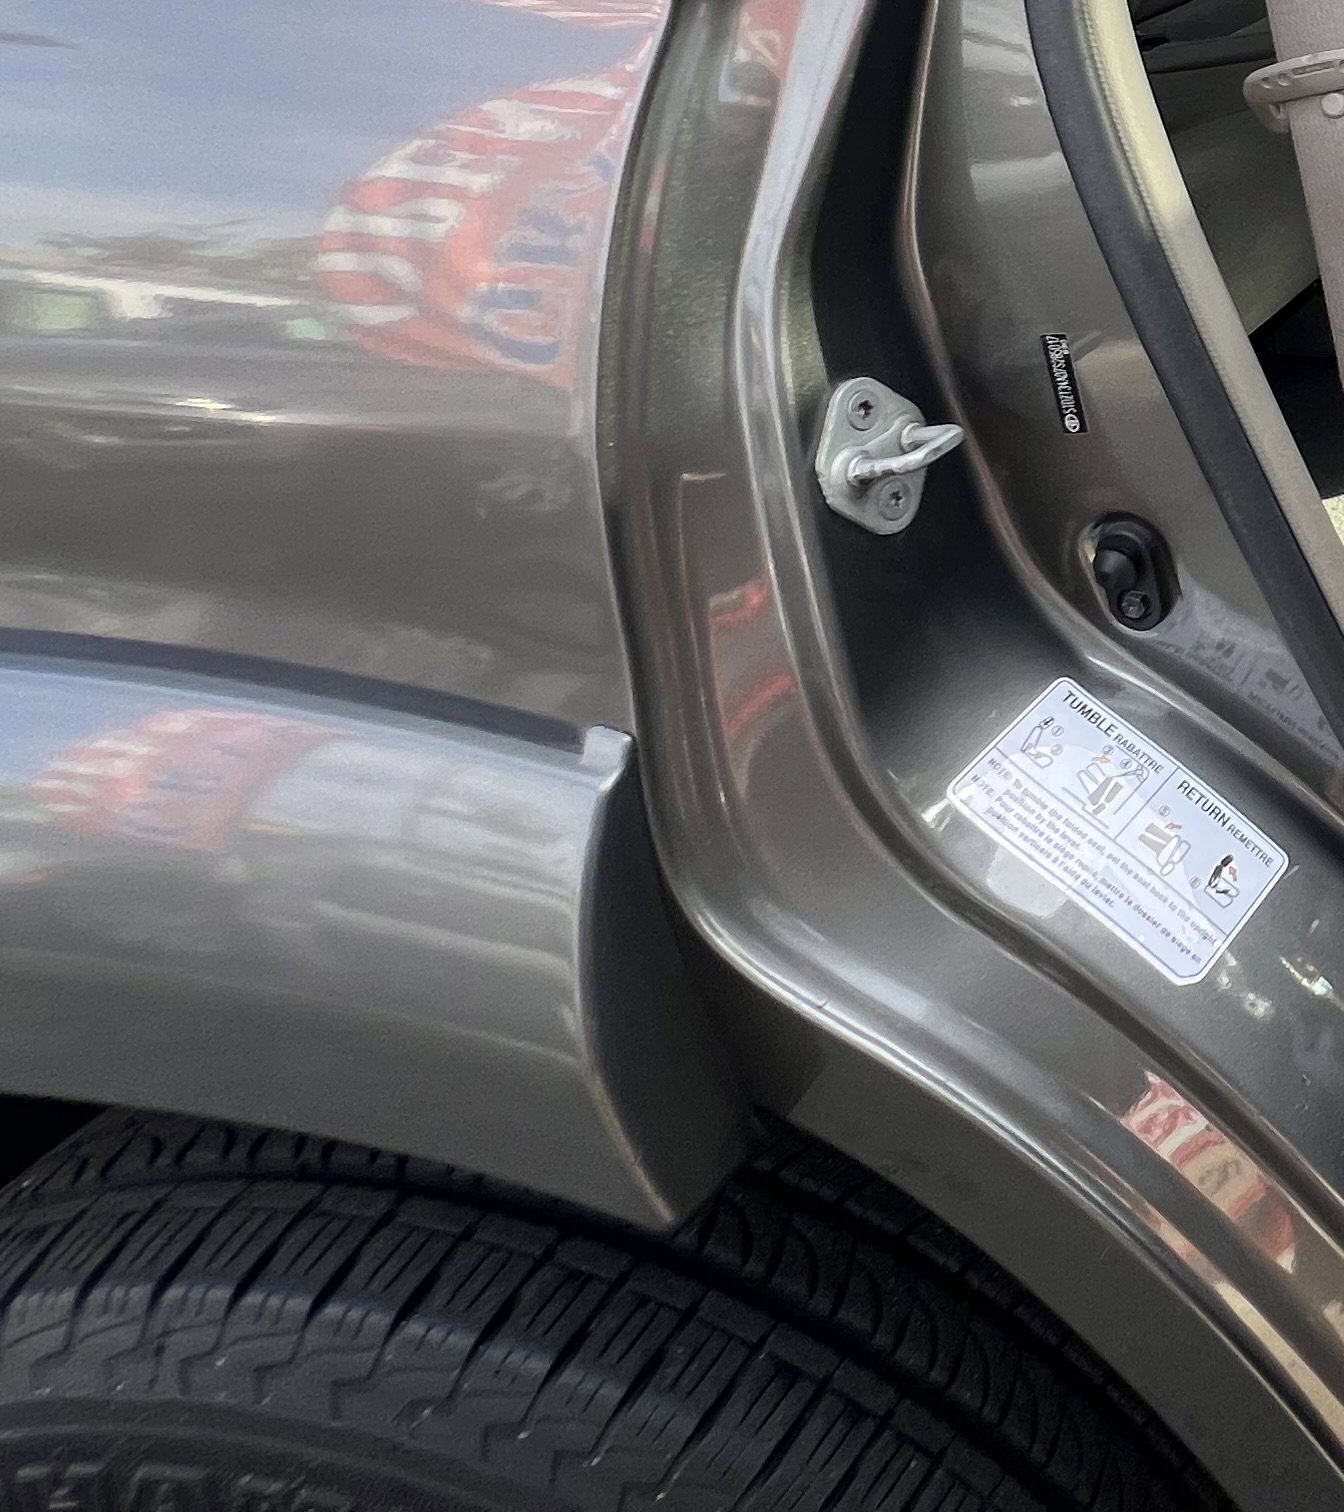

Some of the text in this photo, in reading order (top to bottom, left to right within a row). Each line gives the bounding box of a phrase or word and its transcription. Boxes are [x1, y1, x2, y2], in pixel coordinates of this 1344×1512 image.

[1062, 689, 1164, 774] TUMBLE RABATTRE
[1177, 779, 1275, 869] RETURN REMETTRE
